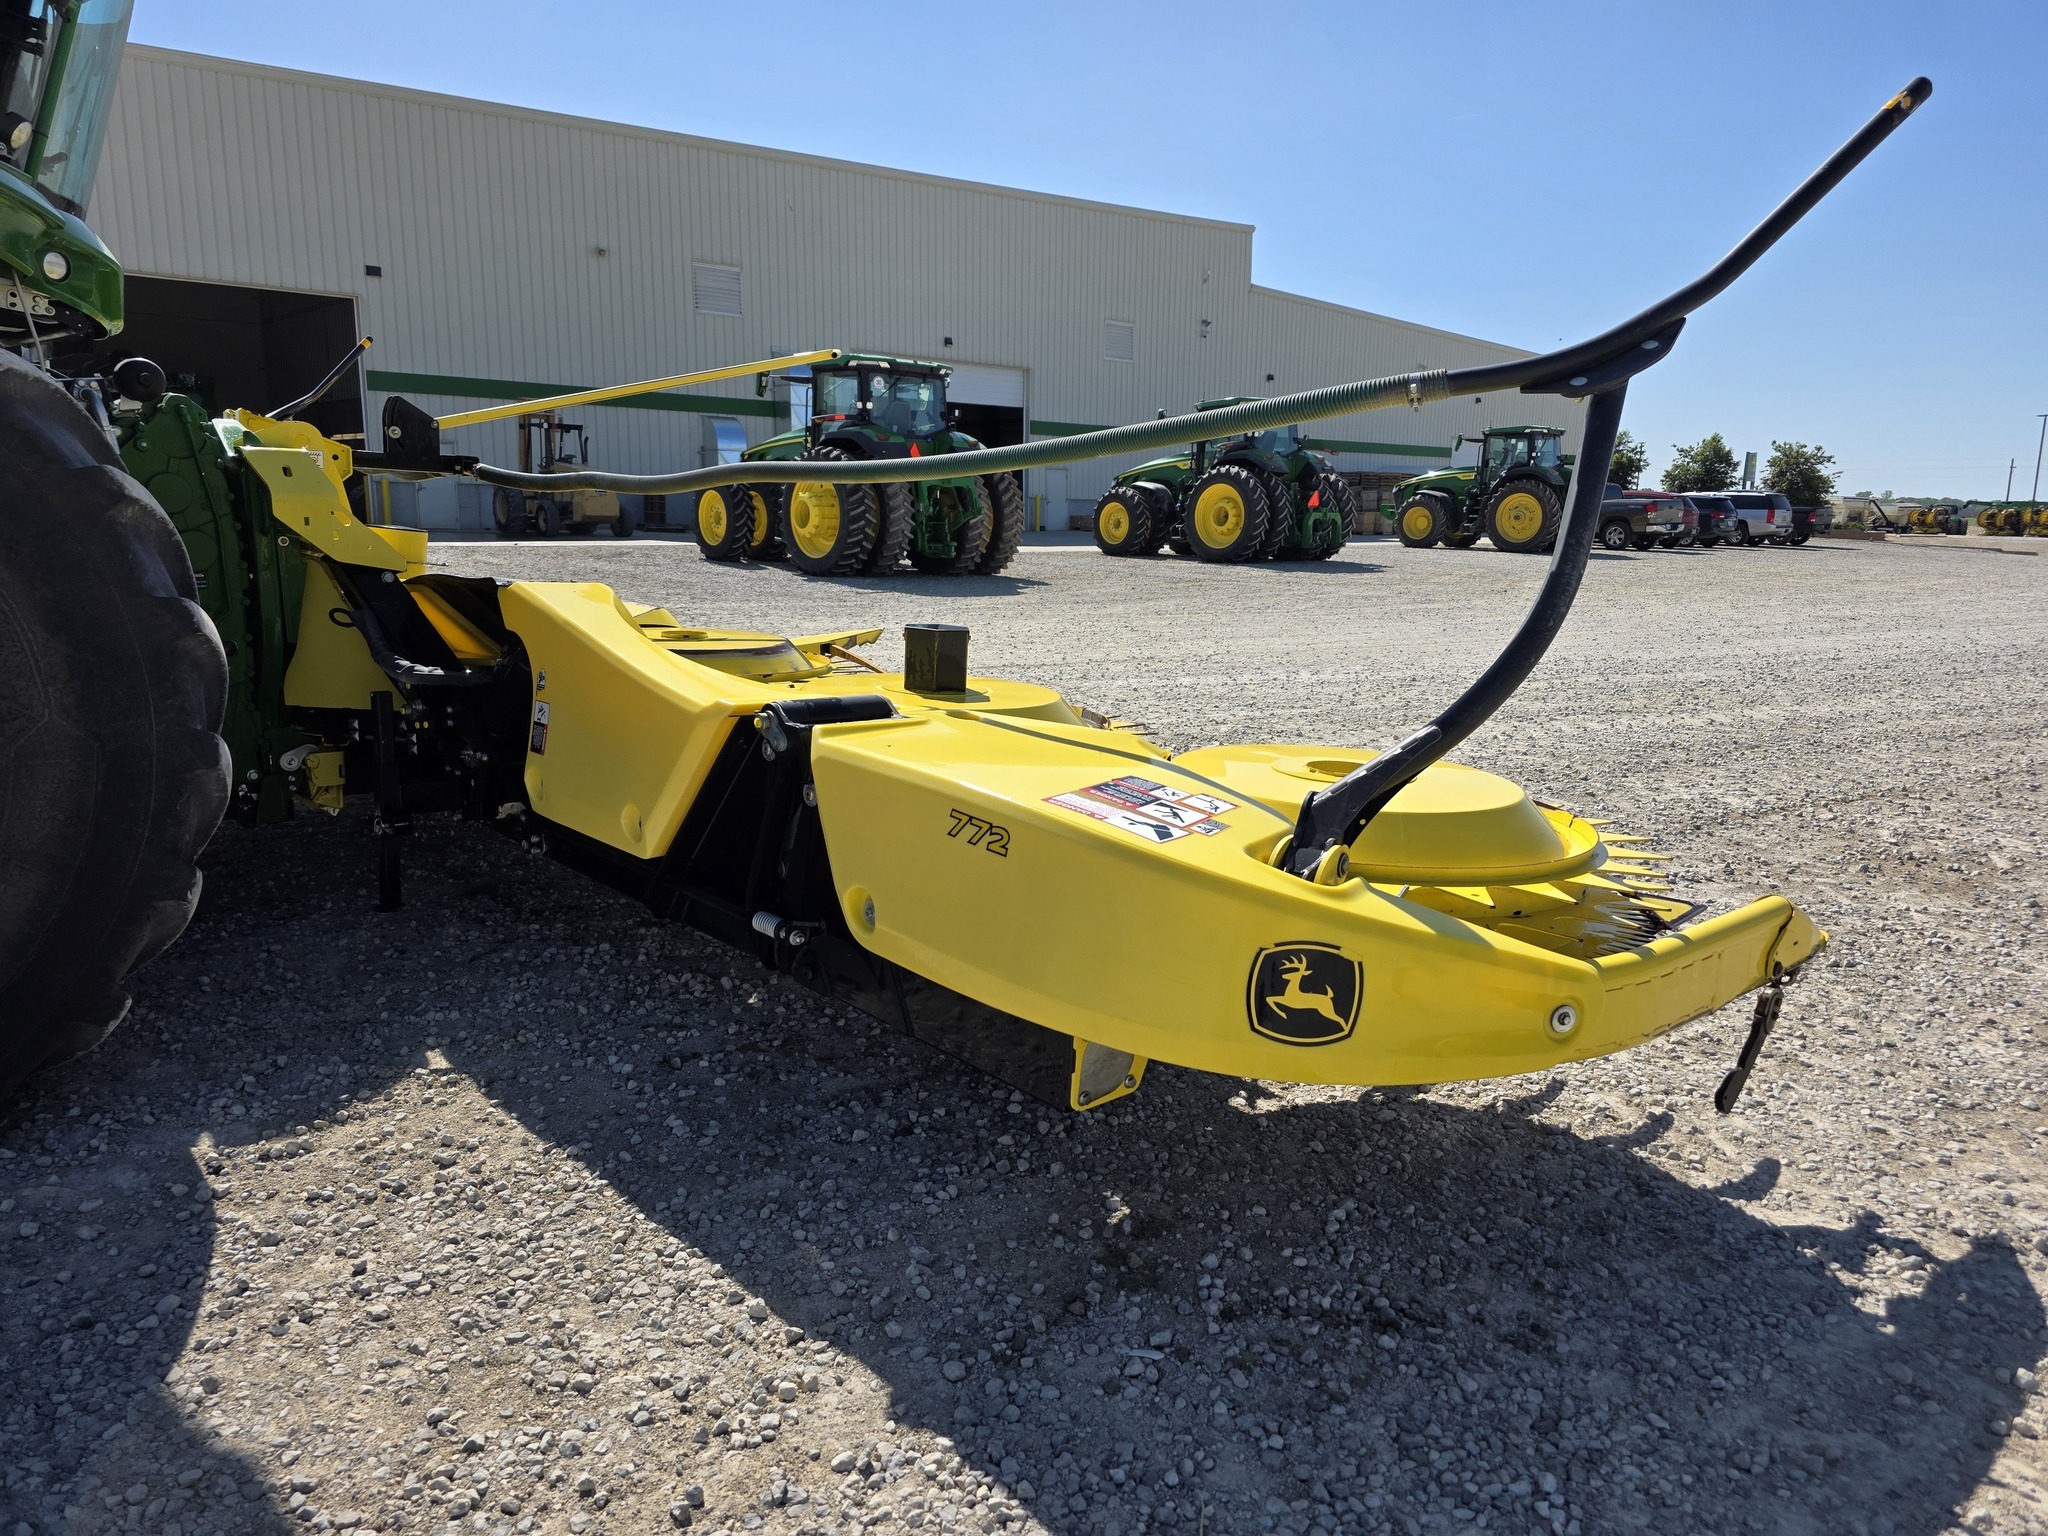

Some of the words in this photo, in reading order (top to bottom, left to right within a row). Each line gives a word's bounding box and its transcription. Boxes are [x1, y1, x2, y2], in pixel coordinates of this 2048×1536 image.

[1089, 789, 1124, 804] DANGER
[1048, 799, 1092, 815] DANGER
[947, 808, 1010, 857] 772
